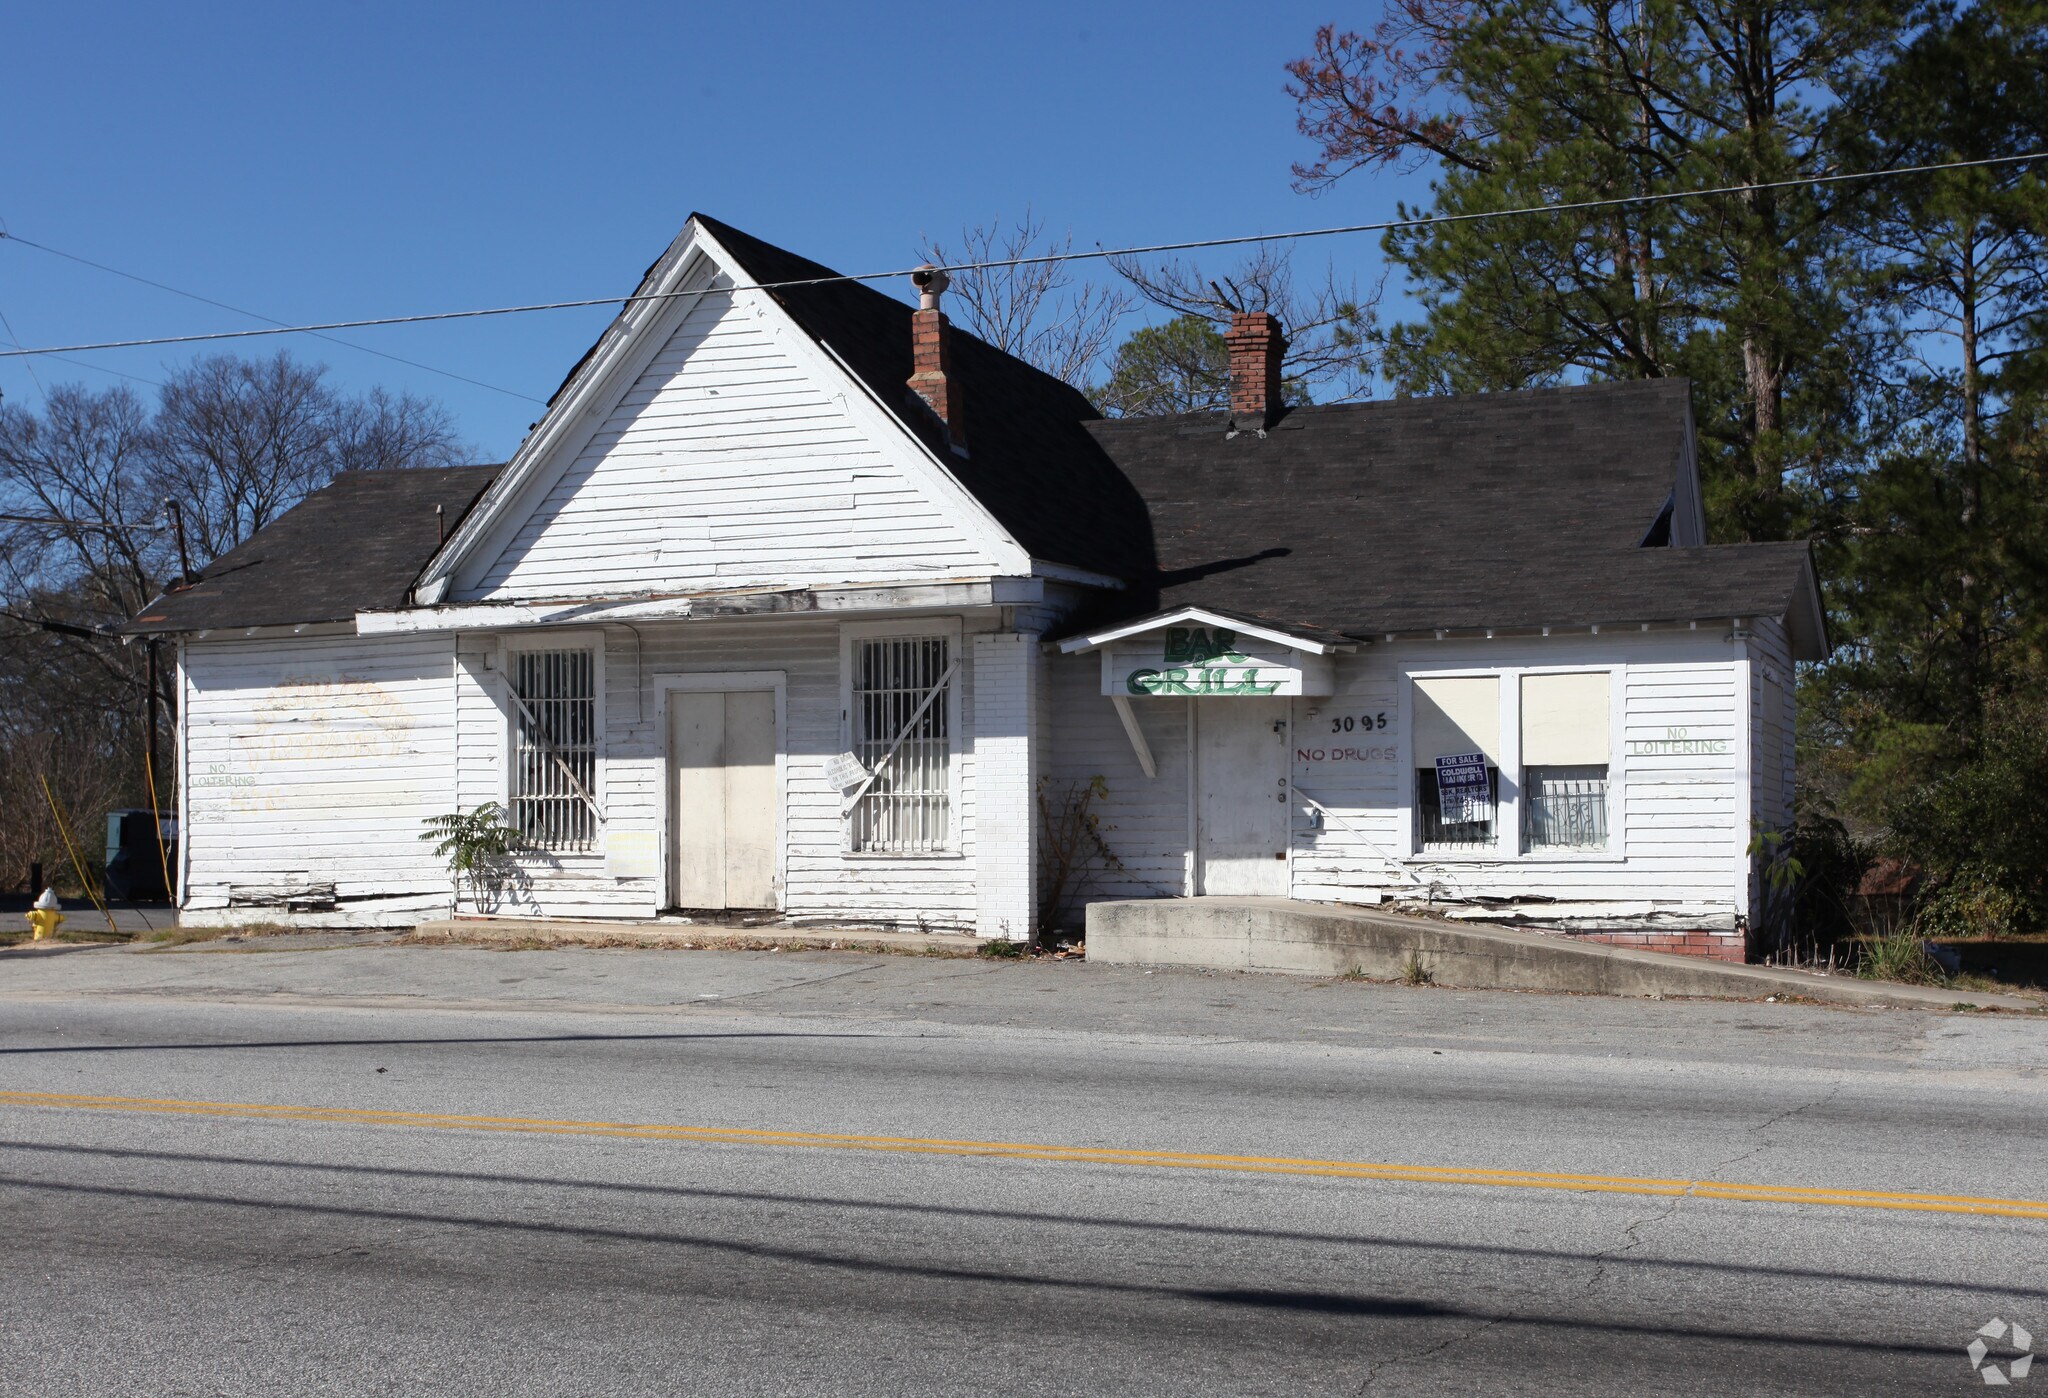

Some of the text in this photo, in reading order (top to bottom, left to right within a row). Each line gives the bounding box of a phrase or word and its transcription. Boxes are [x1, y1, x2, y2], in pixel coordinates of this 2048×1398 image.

[1164, 627, 1251, 663] BAR
[1127, 668, 1281, 695] GRILL
[1331, 712, 1387, 733] 3095
[1667, 727, 1688, 740] NO
[1297, 747, 1397, 761] NO DRUGS
[1633, 741, 1727, 755] LOITERING
[1458, 755, 1478, 764] SALE
[209, 763, 226, 773] NO
[191, 776, 256, 787] LOITERING
[1456, 786, 1487, 794] REALTORS
